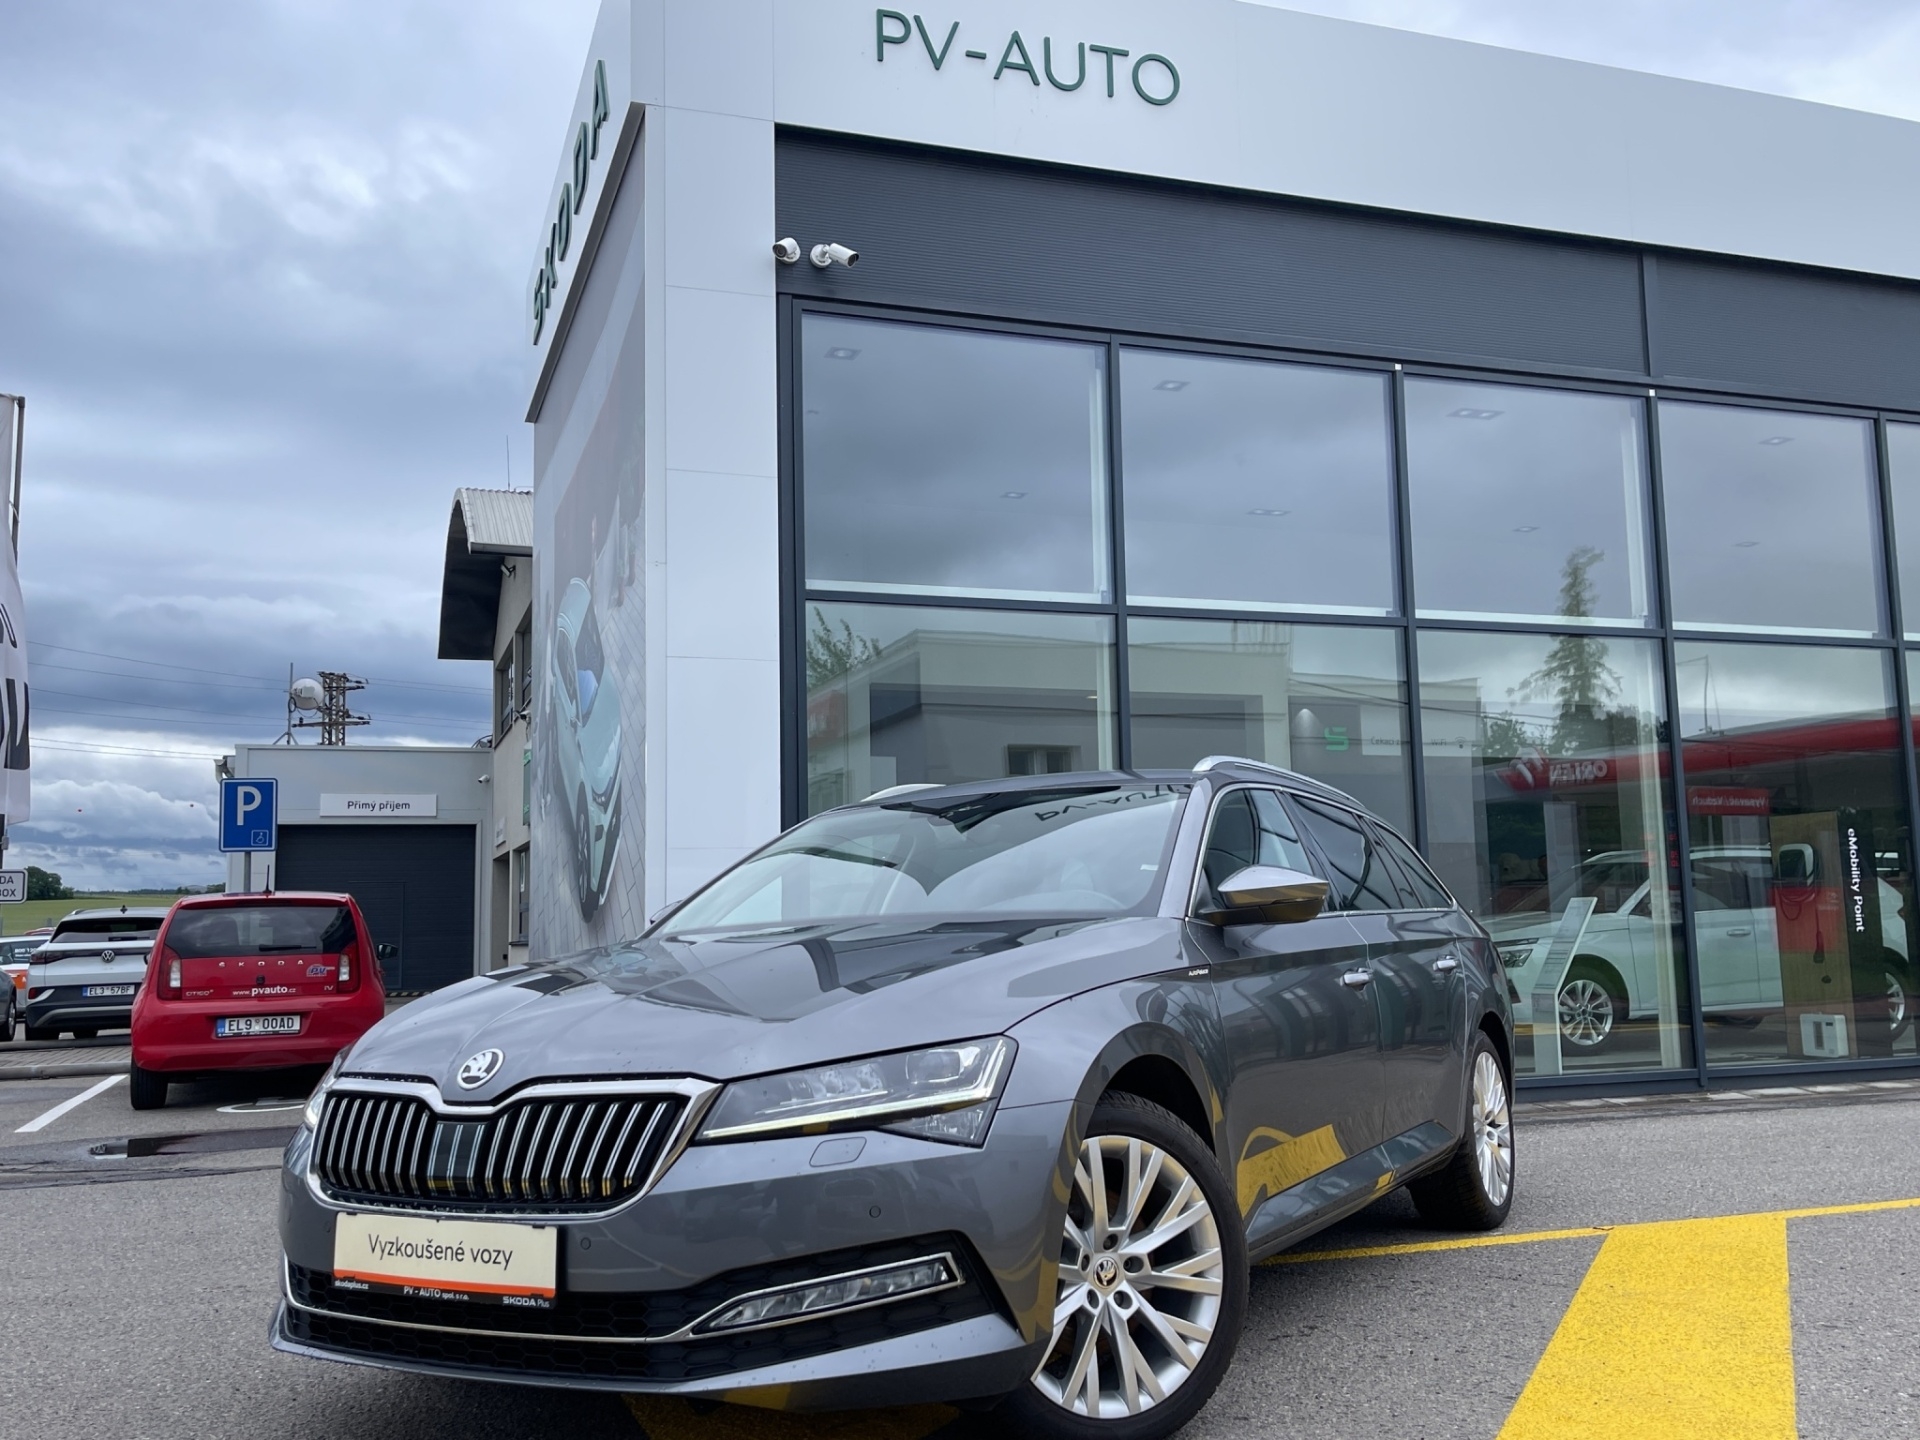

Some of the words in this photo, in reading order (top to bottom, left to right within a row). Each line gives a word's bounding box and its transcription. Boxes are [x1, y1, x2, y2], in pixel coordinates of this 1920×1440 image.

[876, 8, 1180, 106] PV-AUTO
[237, 785, 262, 826] P
[1847, 828, 1861, 892] eMobility
[1853, 896, 1865, 932] Point
[232, 985, 296, 997] www.pvauto.cz
[368, 1233, 465, 1262] Vyzkoušené
[470, 1248, 513, 1270] vozy
[403, 1286, 414, 1295] PV
[419, 1288, 441, 1298] AUTO
[537, 1299, 550, 1308] Plus
